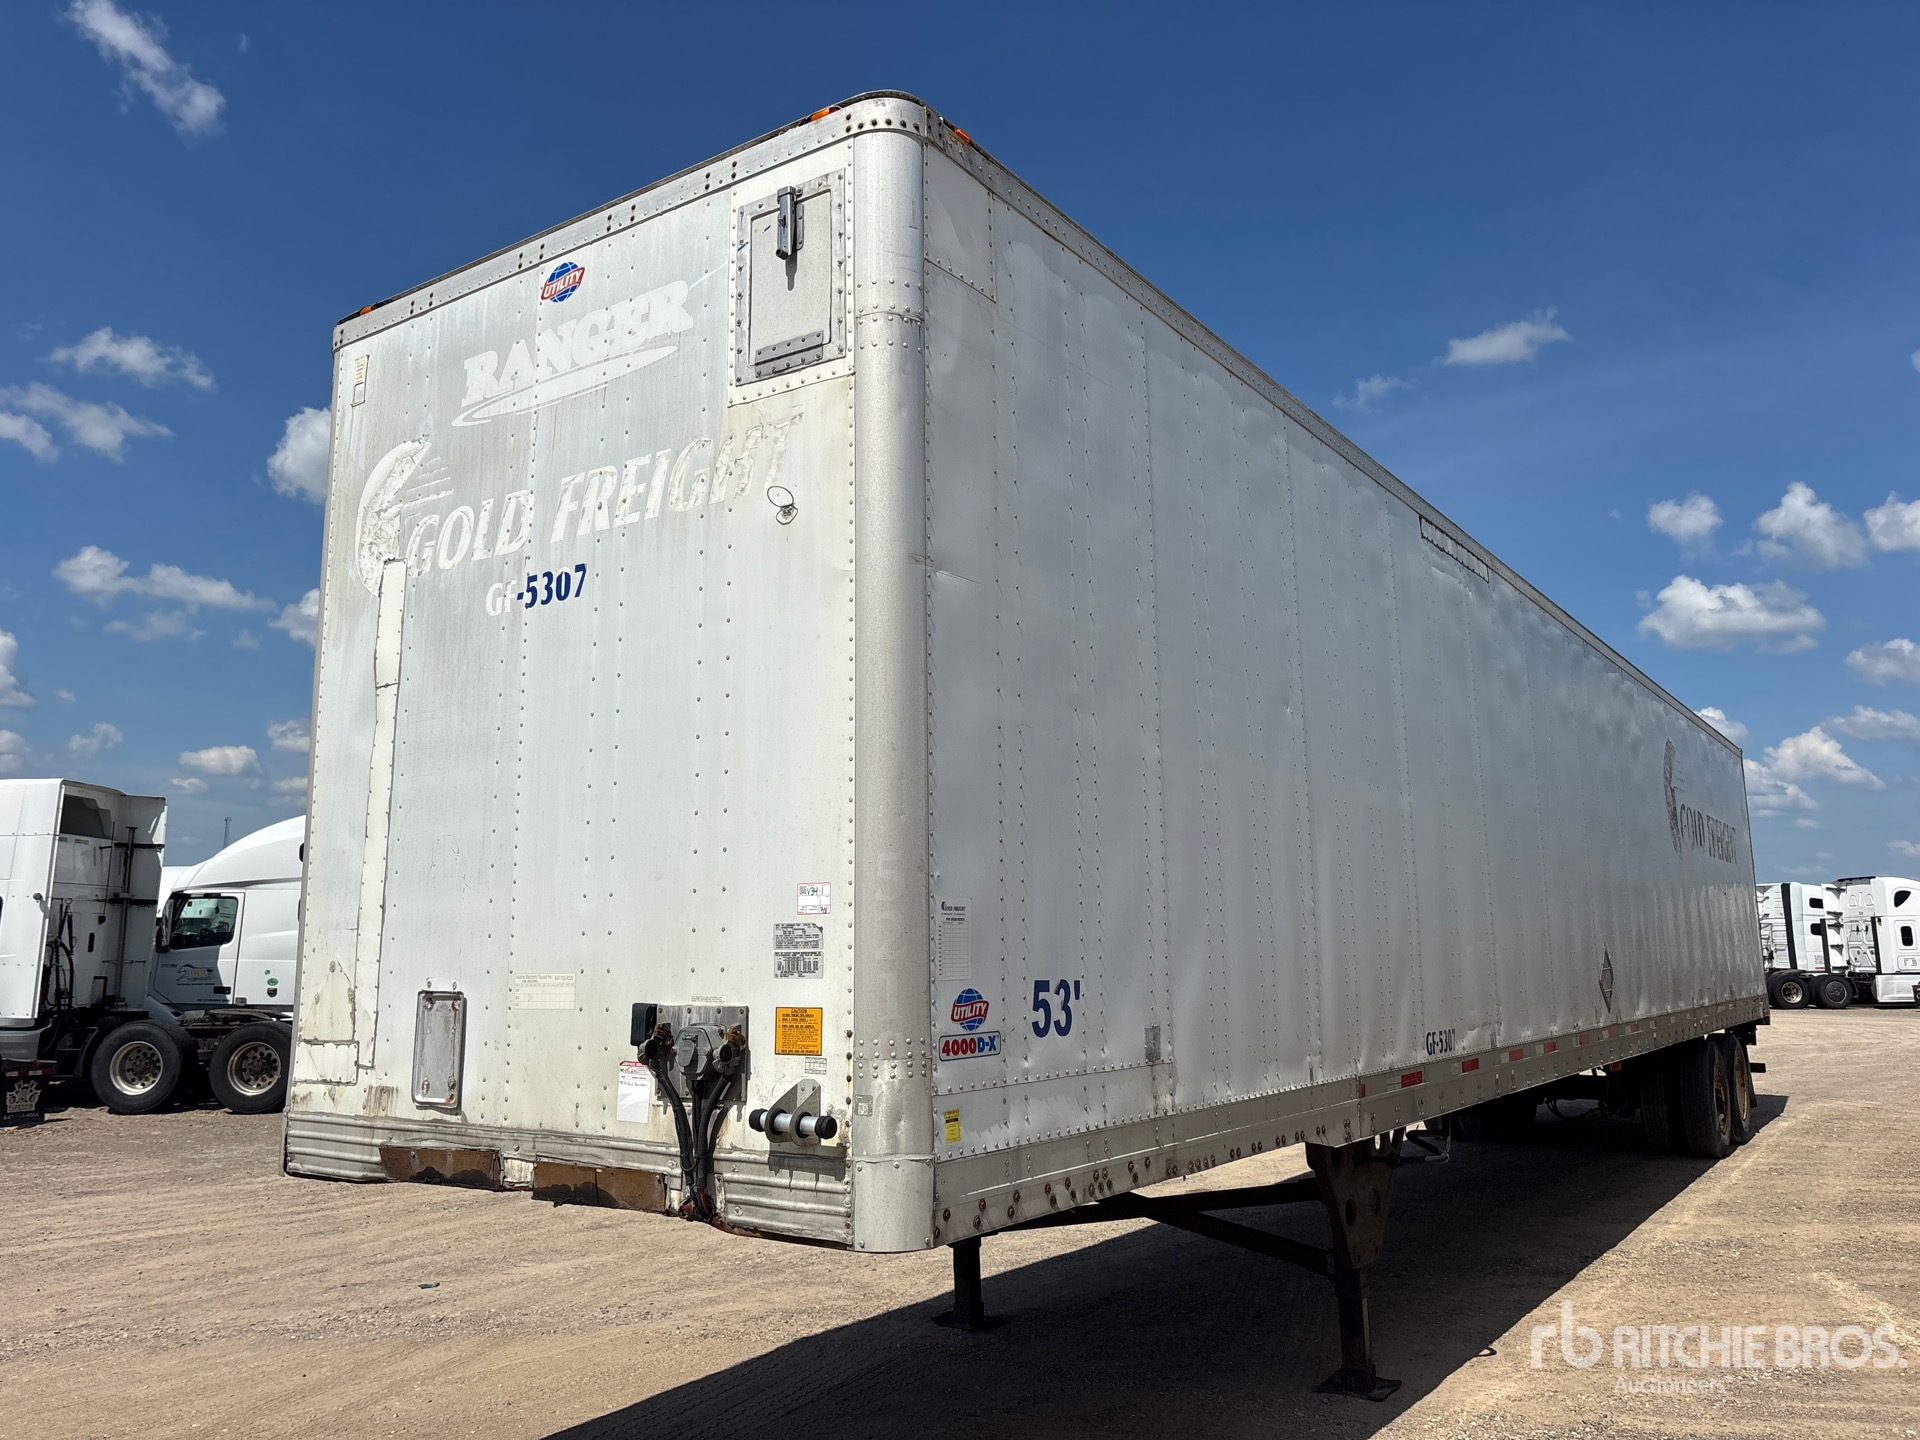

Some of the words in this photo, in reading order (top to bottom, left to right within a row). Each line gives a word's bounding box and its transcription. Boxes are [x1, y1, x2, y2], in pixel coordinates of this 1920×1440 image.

[544, 269, 583, 298] UTILITY
[461, 280, 694, 408] RANGER
[406, 489, 535, 578] GOLD
[551, 412, 803, 543] FREIGHT
[953, 1002, 987, 1020] UTILITY
[1032, 979, 1081, 1038] 53'
[1425, 1028, 1456, 1056] GF-5307
